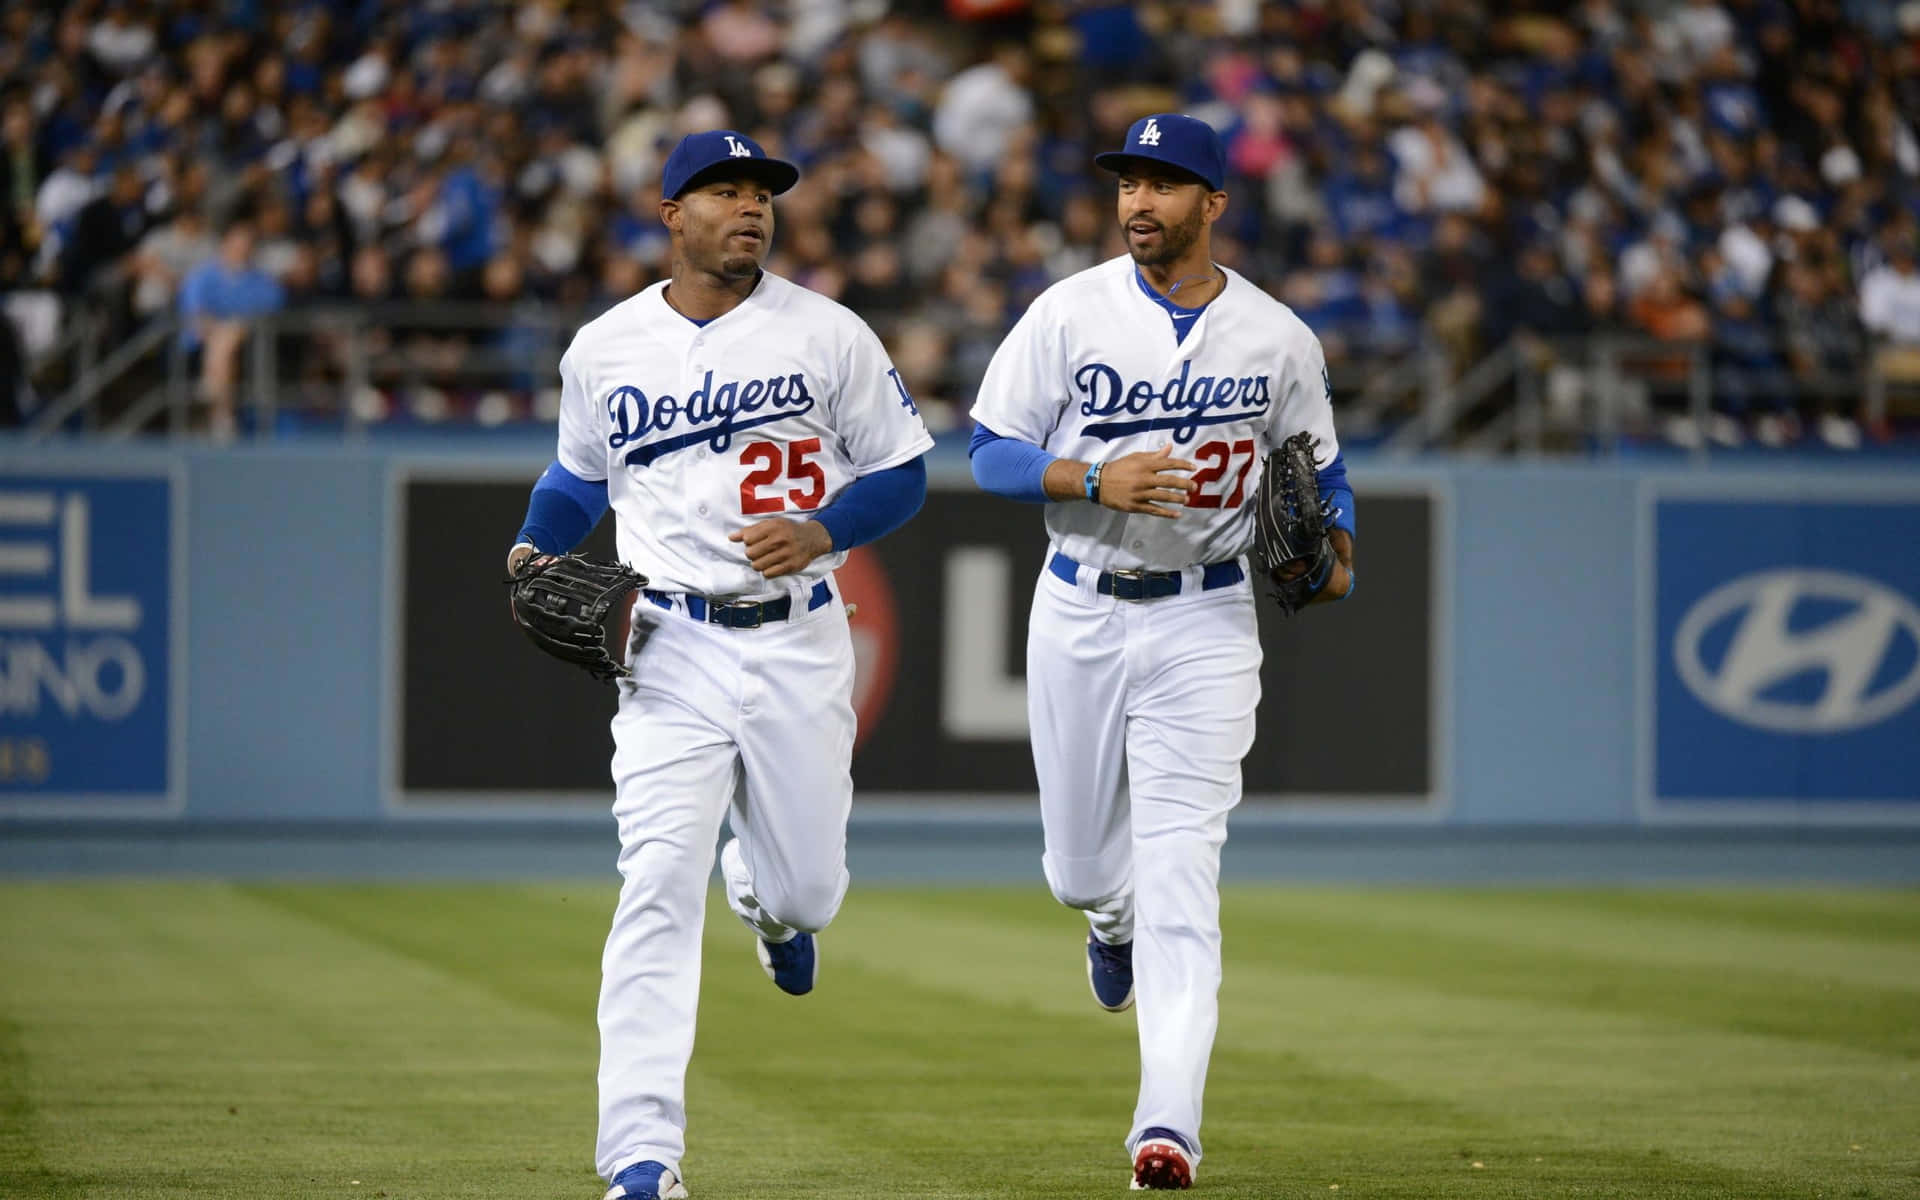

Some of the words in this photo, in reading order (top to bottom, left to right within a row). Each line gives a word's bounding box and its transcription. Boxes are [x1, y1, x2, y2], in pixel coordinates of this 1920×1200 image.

[723, 135, 752, 158] LA
[1138, 118, 1162, 147] LA
[607, 370, 815, 464] Dodgers
[1075, 359, 1271, 444] Dodgers
[739, 437, 826, 515] 25
[1183, 438, 1255, 509] 27
[0, 637, 146, 719] INO
